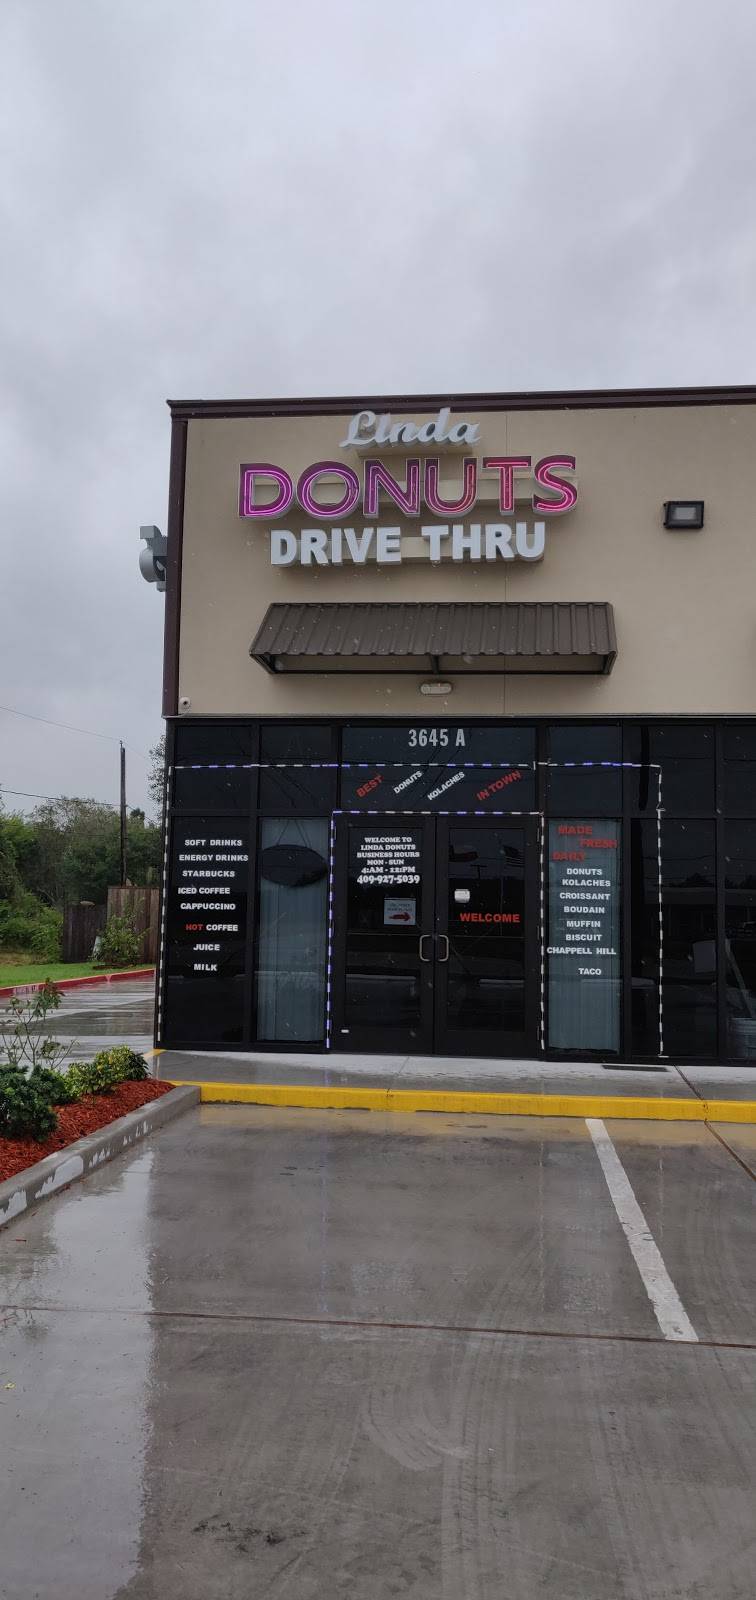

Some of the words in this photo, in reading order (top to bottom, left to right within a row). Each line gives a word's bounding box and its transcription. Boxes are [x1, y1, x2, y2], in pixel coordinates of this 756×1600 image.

[339, 408, 481, 448] Linda
[239, 455, 578, 518] DONUTS
[270, 526, 401, 567] DRIVE
[421, 521, 546, 561] THRU
[408, 728, 449, 747] 3645
[455, 728, 466, 747] A
[356, 775, 383, 797] BEST
[393, 770, 423, 794] DONUTS
[427, 771, 466, 800] KOLACHES
[476, 788, 489, 801] IN
[488, 770, 522, 794] TOWN
[558, 825, 593, 835] MADE
[580, 839, 618, 848] FRESH
[552, 852, 586, 861] DAILY
[356, 875, 420, 884] 409-927-5039
[562, 879, 611, 887] KOLACHES
[559, 892, 611, 900] CROISSANT
[563, 905, 605, 914] BOUDAIN
[459, 912, 521, 923] WELCOME
[185, 923, 203, 931] HOT
[206, 923, 238, 931] COFFEE
[566, 920, 601, 928] MUFFIN
[546, 947, 593, 955] CHAPPELL
[193, 963, 218, 971] MILK
[578, 967, 602, 975] TACO
